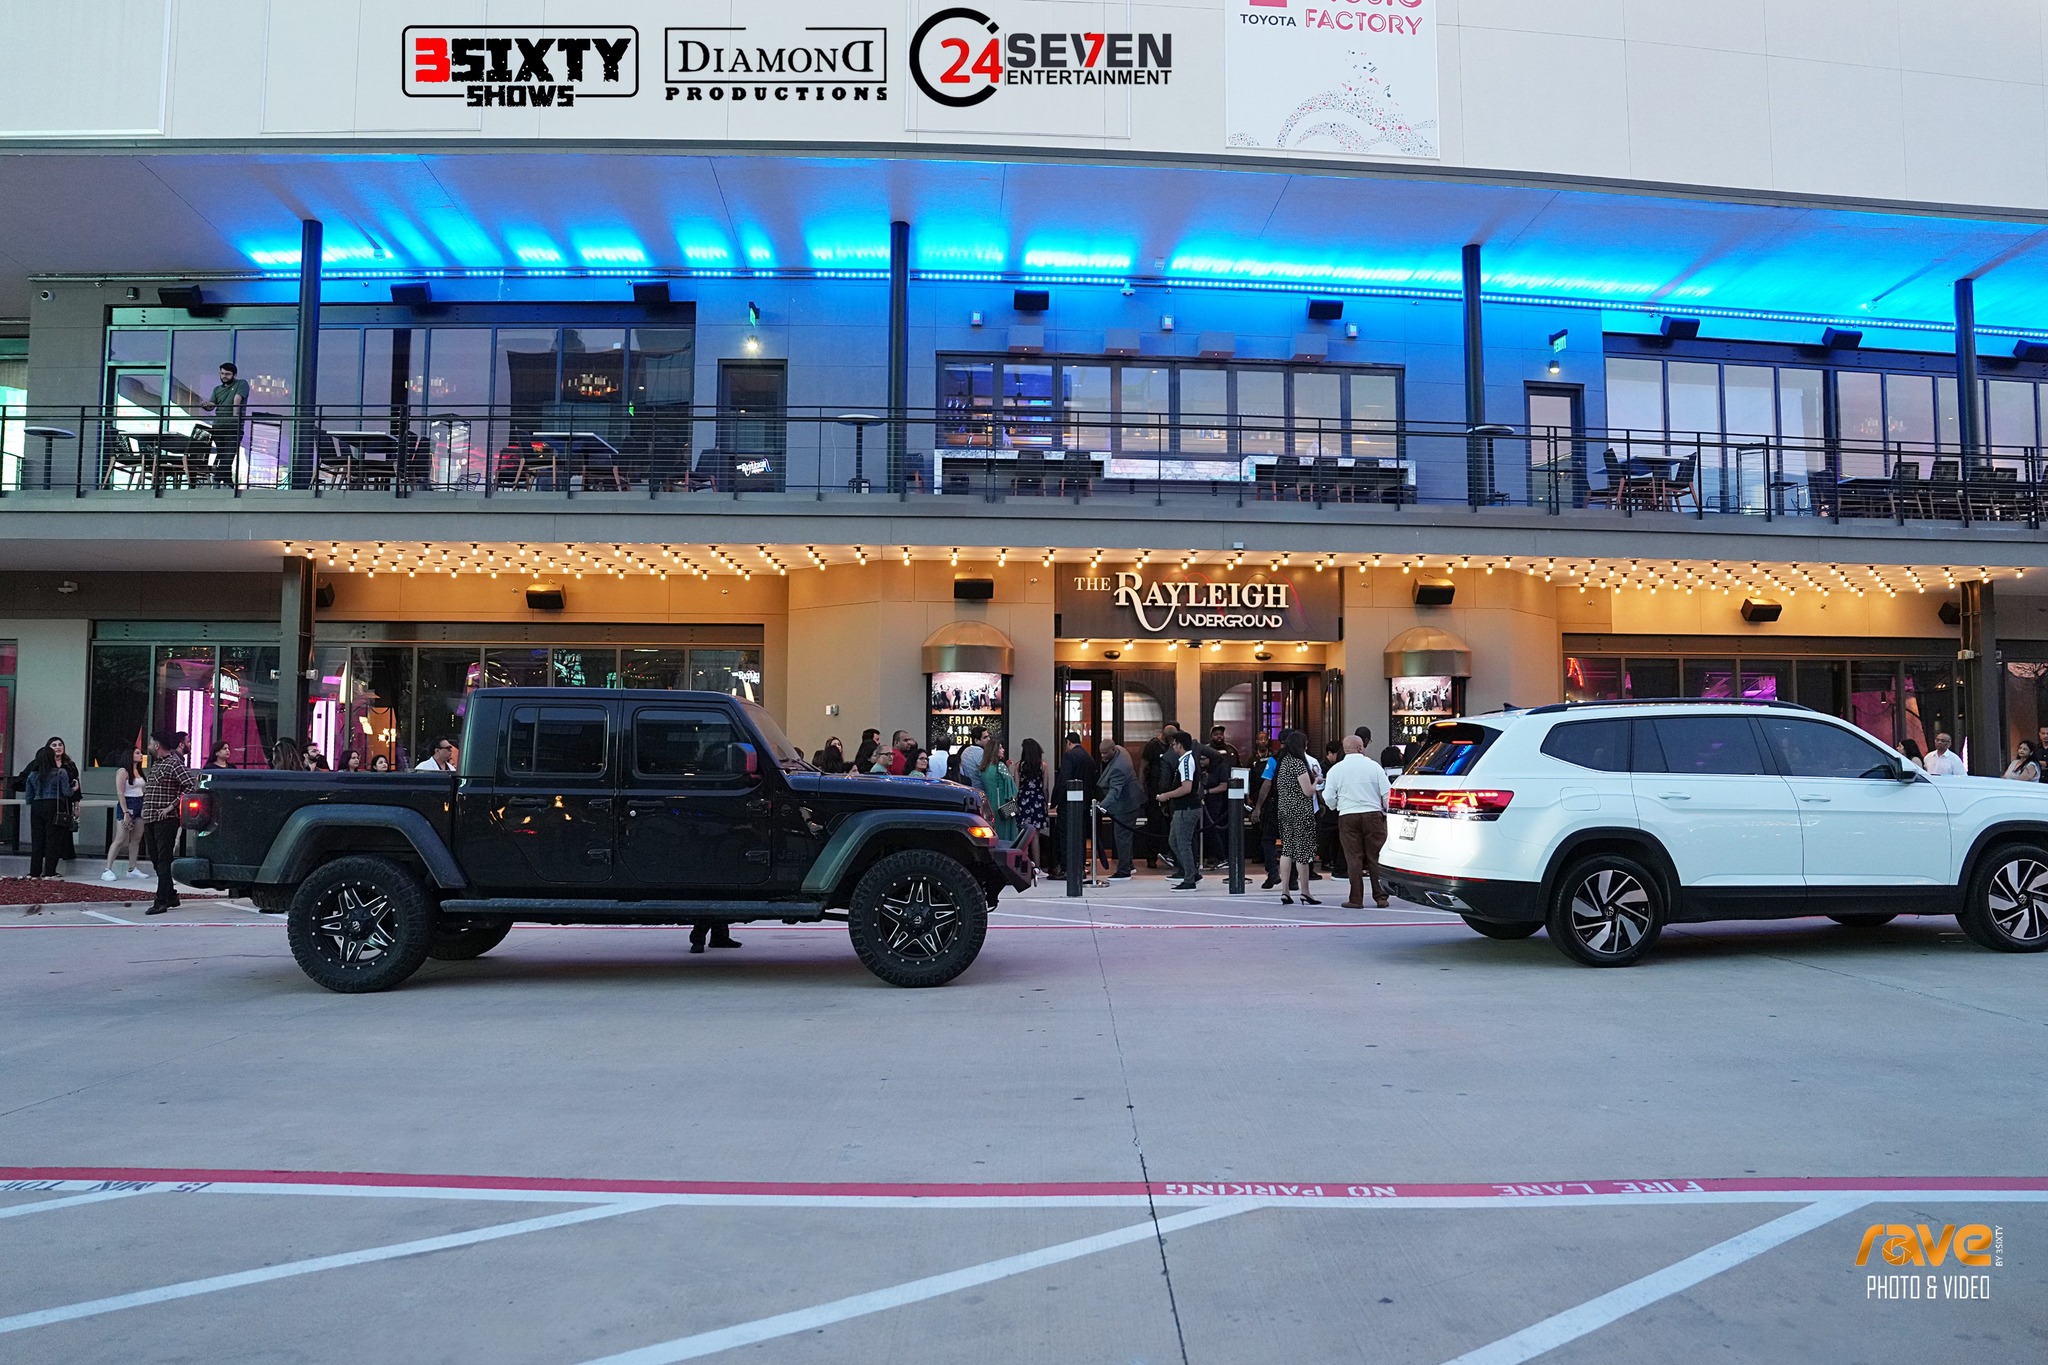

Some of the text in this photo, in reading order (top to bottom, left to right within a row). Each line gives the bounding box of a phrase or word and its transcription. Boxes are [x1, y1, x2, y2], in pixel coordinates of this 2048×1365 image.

[1240, 8, 1422, 35] TOYOTA FACTORY
[1074, 571, 1290, 631] THE RAYLEIGH
[1178, 613, 1283, 628] UNDERGROUND
[949, 716, 985, 725] FRIDAY
[1165, 1183, 1397, 1197] NO PARKING
[1492, 1180, 1705, 1196] FIRE LANE
